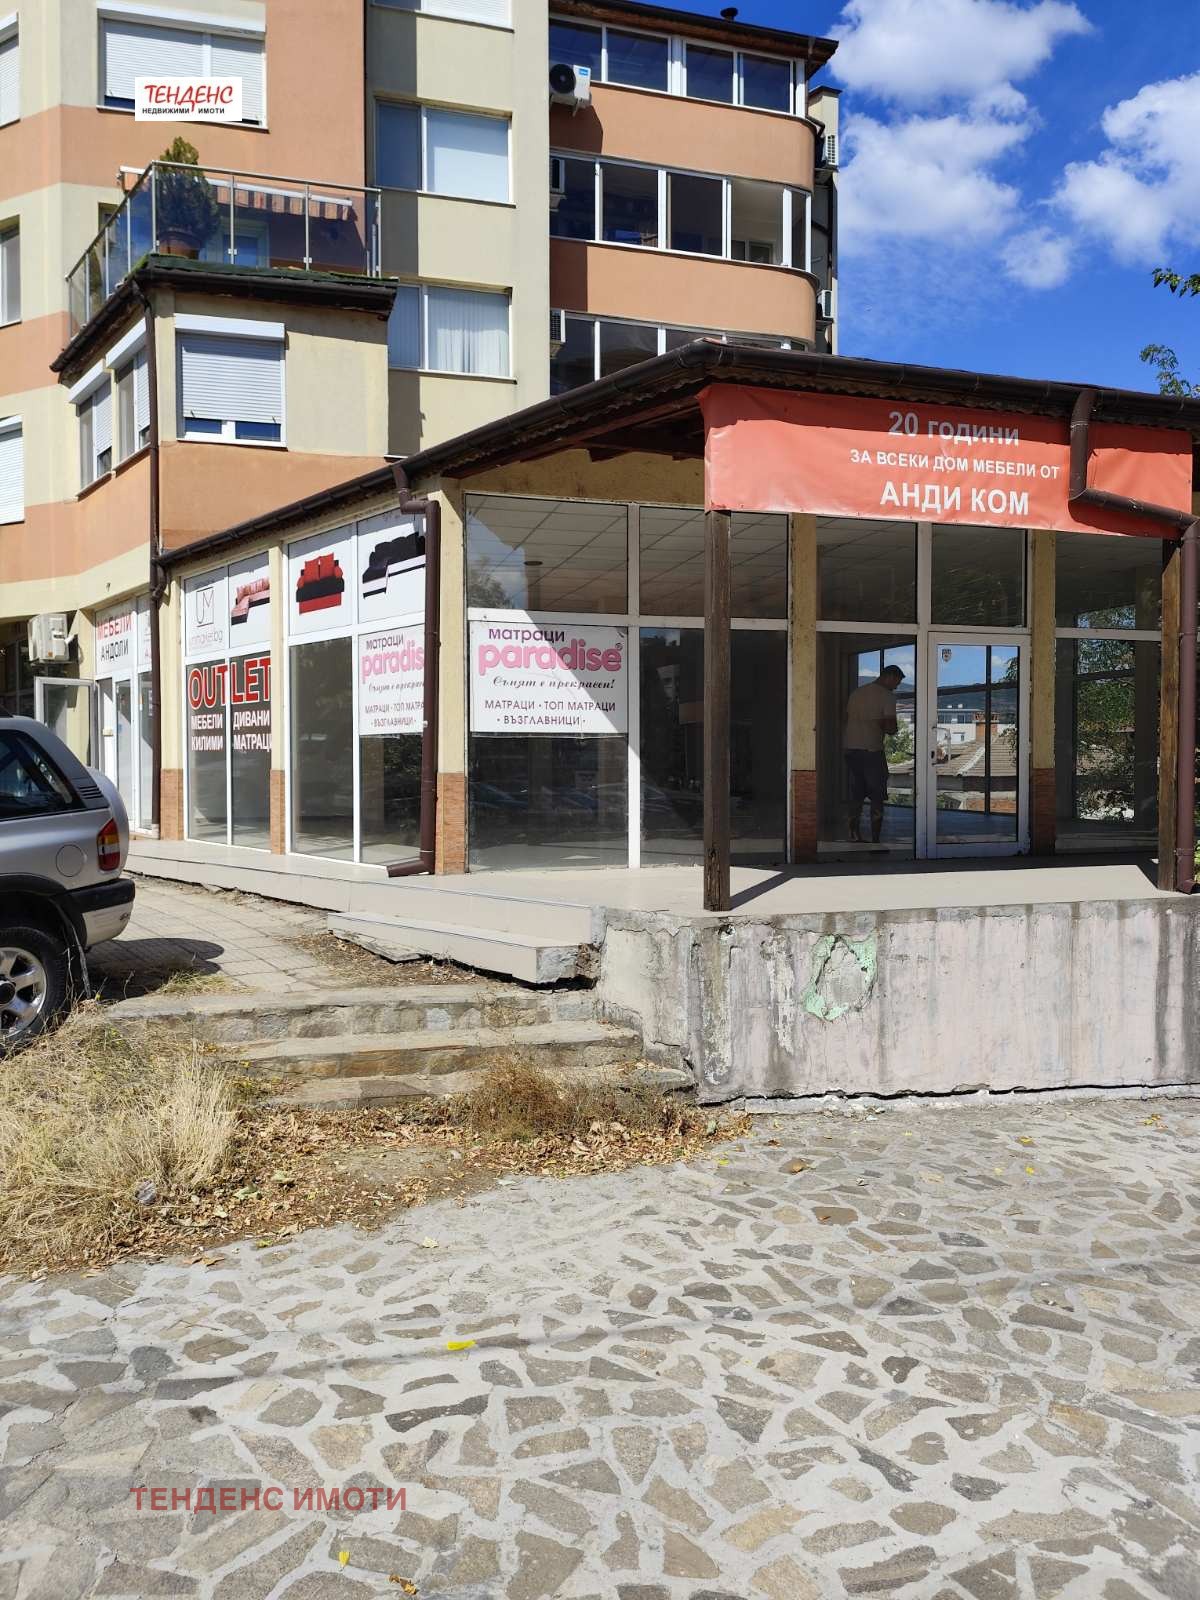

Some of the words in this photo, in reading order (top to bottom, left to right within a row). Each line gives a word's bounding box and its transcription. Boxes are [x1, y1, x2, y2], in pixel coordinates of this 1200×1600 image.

[888, 411, 919, 437] 20
[850, 449, 871, 464] ЗА
[877, 452, 928, 468] ВСЕКИ
[933, 456, 968, 472] ДОМ
[973, 459, 1036, 477] МЕБЕЛИ
[1040, 465, 1060, 479] ОТ
[880, 481, 961, 514] АНДИ
[971, 487, 1029, 515] КОМ
[97, 613, 132, 640] МЕБЕЛИ
[488, 628, 565, 643] матраци
[366, 634, 404, 650] матраци
[362, 640, 424, 684] paradis
[188, 657, 271, 710] OUTLET
[406, 701, 424, 711] МАТРА
[484, 700, 535, 711] МАТРАЦИ
[544, 700, 564, 710] ТОП
[567, 701, 616, 712] МАТРАЦИ
[191, 714, 223, 730] МЕБЕЛИ
[233, 710, 270, 730] ДИВАНИ
[503, 715, 580, 725] ВЪЗГЛАВНИЦИ
[192, 736, 223, 751] КИЛИМИ
